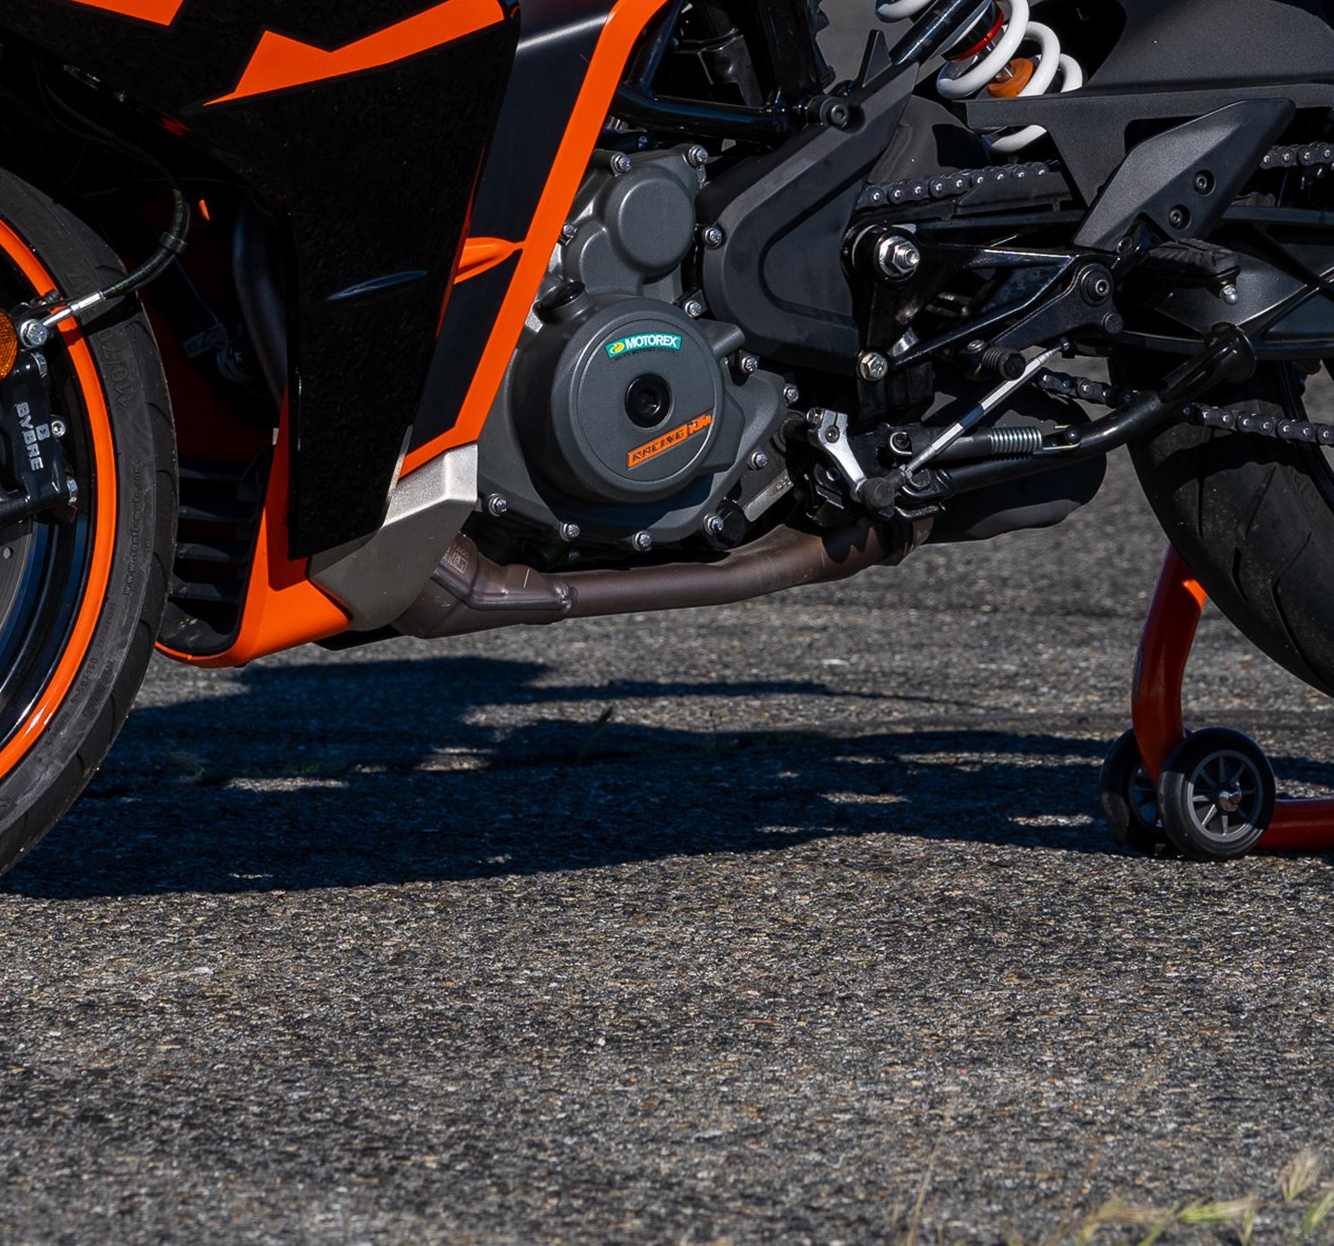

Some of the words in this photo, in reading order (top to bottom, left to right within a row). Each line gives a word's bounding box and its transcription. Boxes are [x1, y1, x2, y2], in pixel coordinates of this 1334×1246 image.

[624, 334, 678, 350] MOTOREX
[15, 401, 44, 471] BYBRE
[632, 429, 685, 463] RACING
